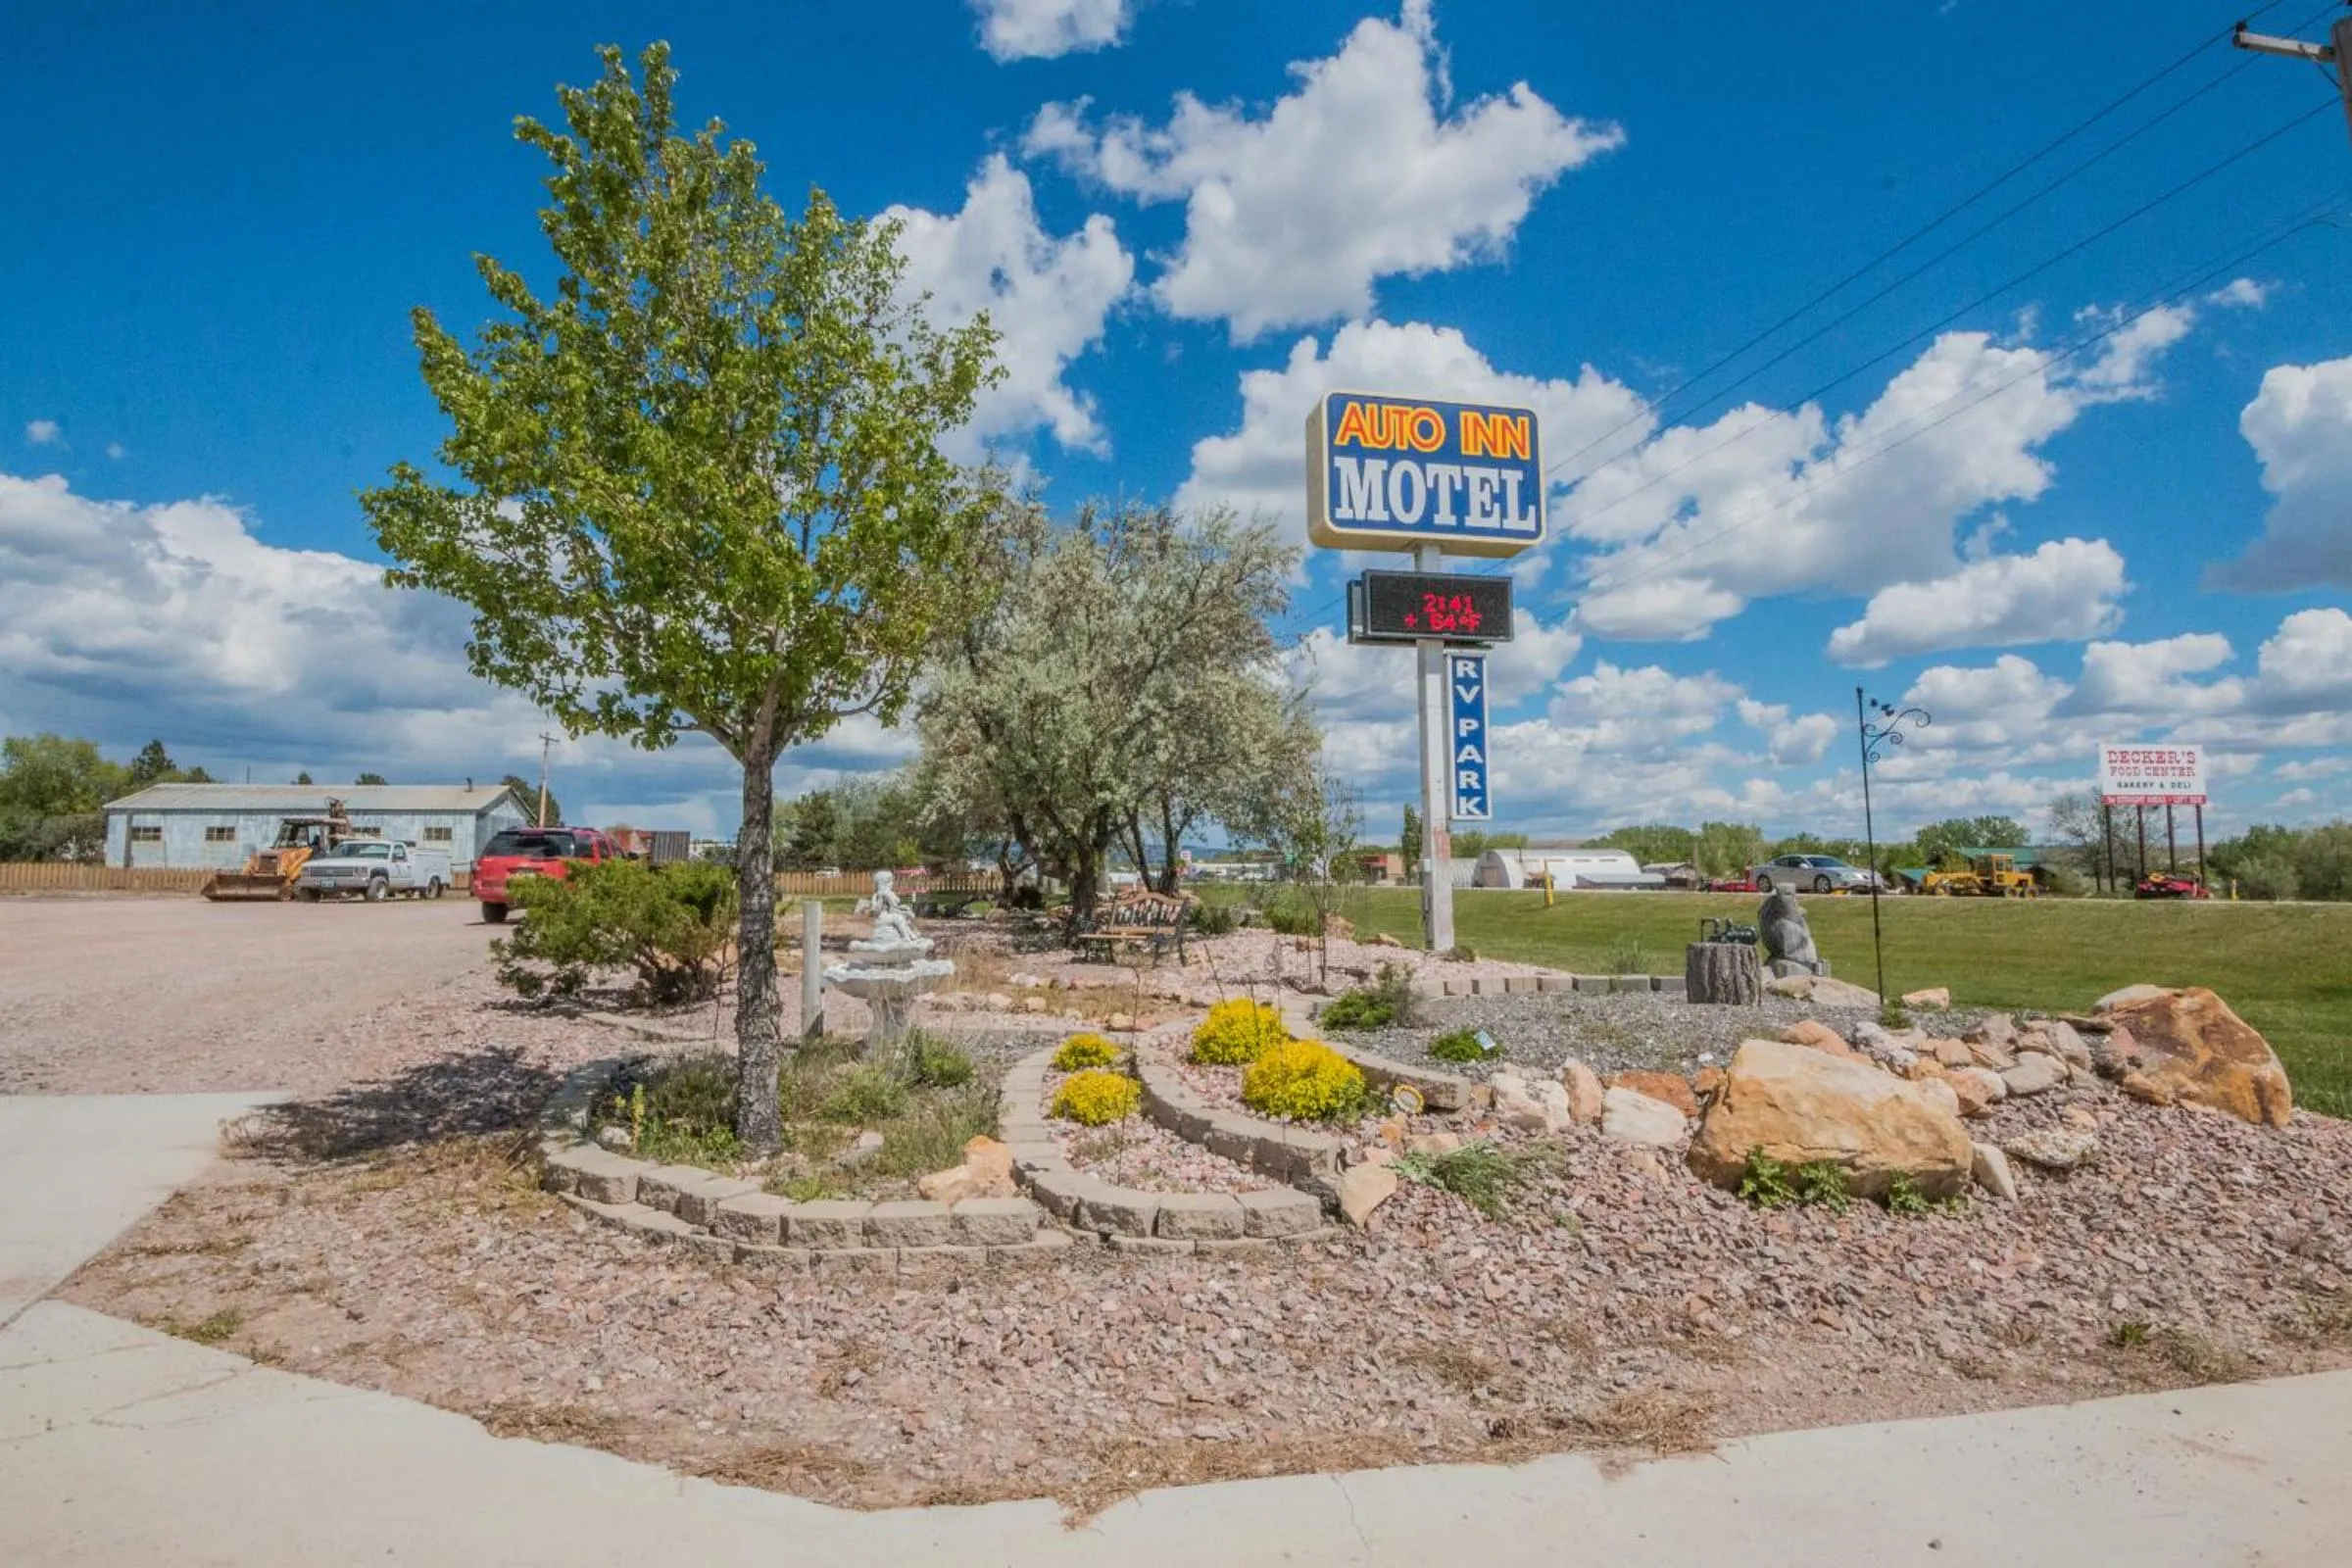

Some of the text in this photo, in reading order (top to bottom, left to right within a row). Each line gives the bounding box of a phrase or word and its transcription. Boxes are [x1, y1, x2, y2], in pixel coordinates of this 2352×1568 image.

[1334, 402, 1531, 460] AUTO INN
[1334, 456, 1537, 532] MOTEL
[1457, 718, 1484, 815] PARK
[2107, 751, 2196, 764] DECKER'S
[2110, 766, 2196, 777] FOOD CENTER
